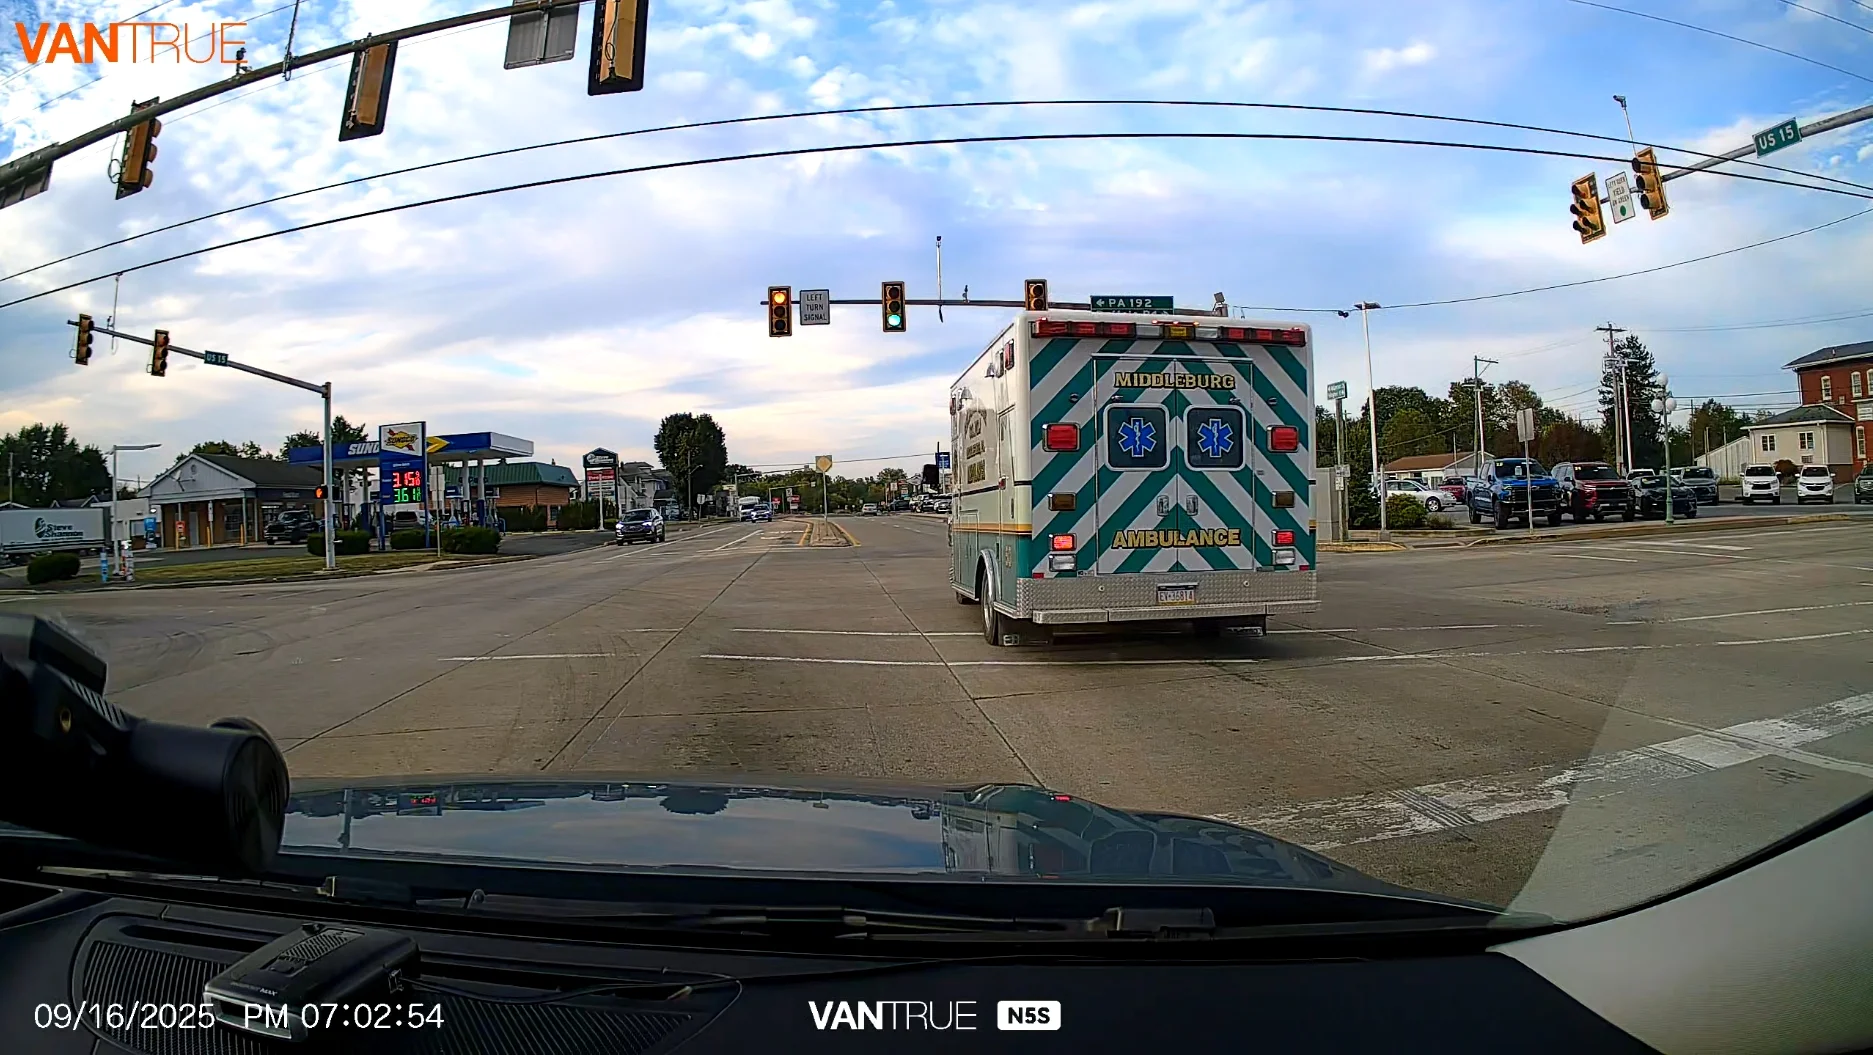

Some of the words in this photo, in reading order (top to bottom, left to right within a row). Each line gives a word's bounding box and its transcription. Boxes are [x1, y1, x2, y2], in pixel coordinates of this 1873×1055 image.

[1759, 133, 1776, 150] US
[1779, 124, 1794, 142] 15
[806, 293, 823, 301] LEFT
[806, 303, 824, 311] TURN
[1108, 298, 1126, 308] PA
[1129, 298, 1153, 308] 192
[803, 313, 827, 321] SIGNAL
[206, 353, 217, 362] US
[217, 355, 227, 364] 15
[1114, 372, 1236, 390] MIDDLEBURG
[47, 523, 74, 531] Steve
[1111, 528, 1241, 549] AMBULANCE
